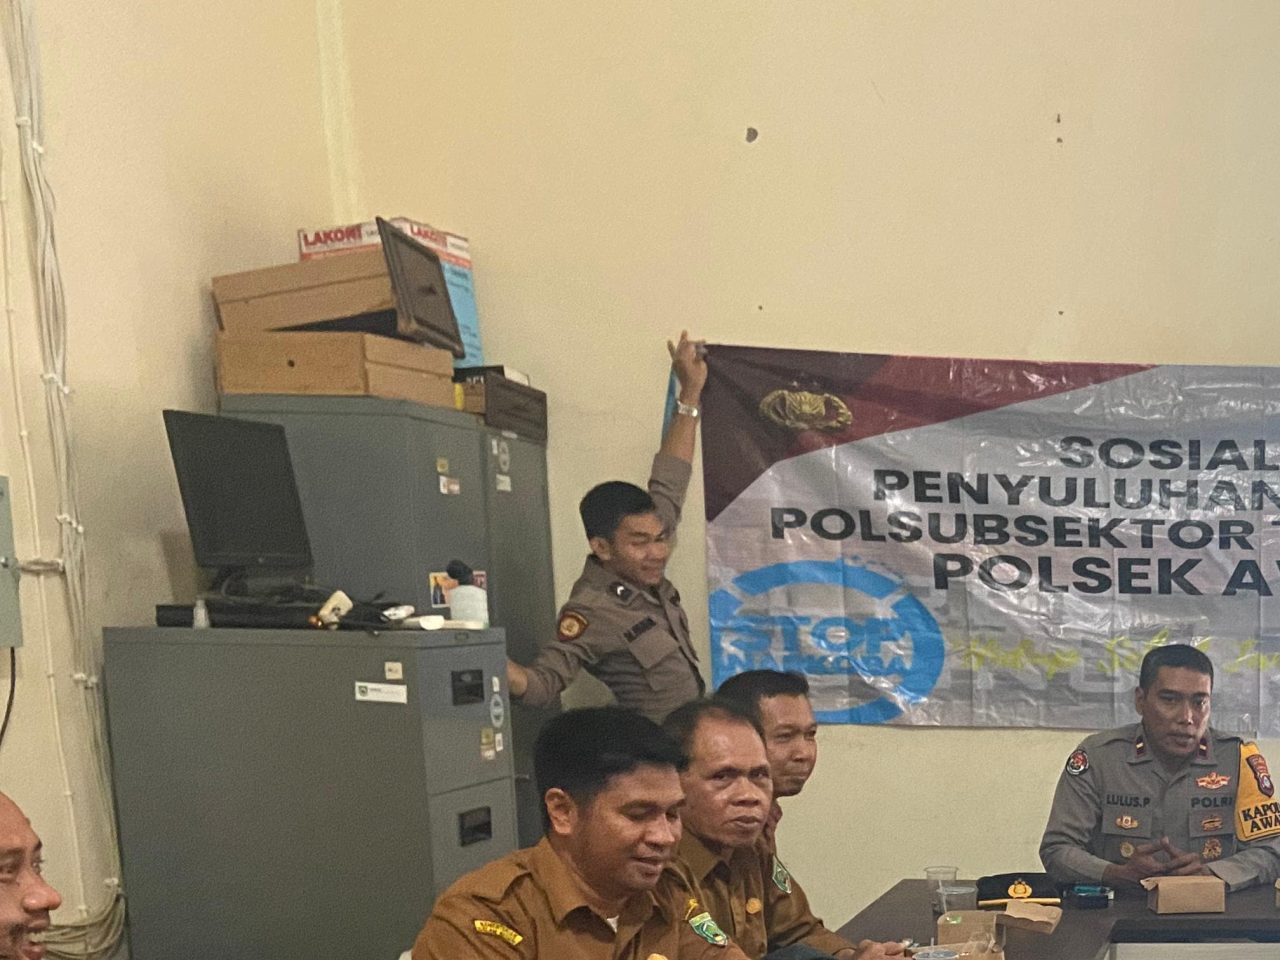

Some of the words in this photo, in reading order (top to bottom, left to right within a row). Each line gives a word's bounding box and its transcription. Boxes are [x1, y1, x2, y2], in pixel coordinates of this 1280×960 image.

[771, 507, 1255, 550] POLSUBSEKTOR
[933, 553, 1204, 596] POLSEK
[1191, 796, 1232, 808] POLRI
